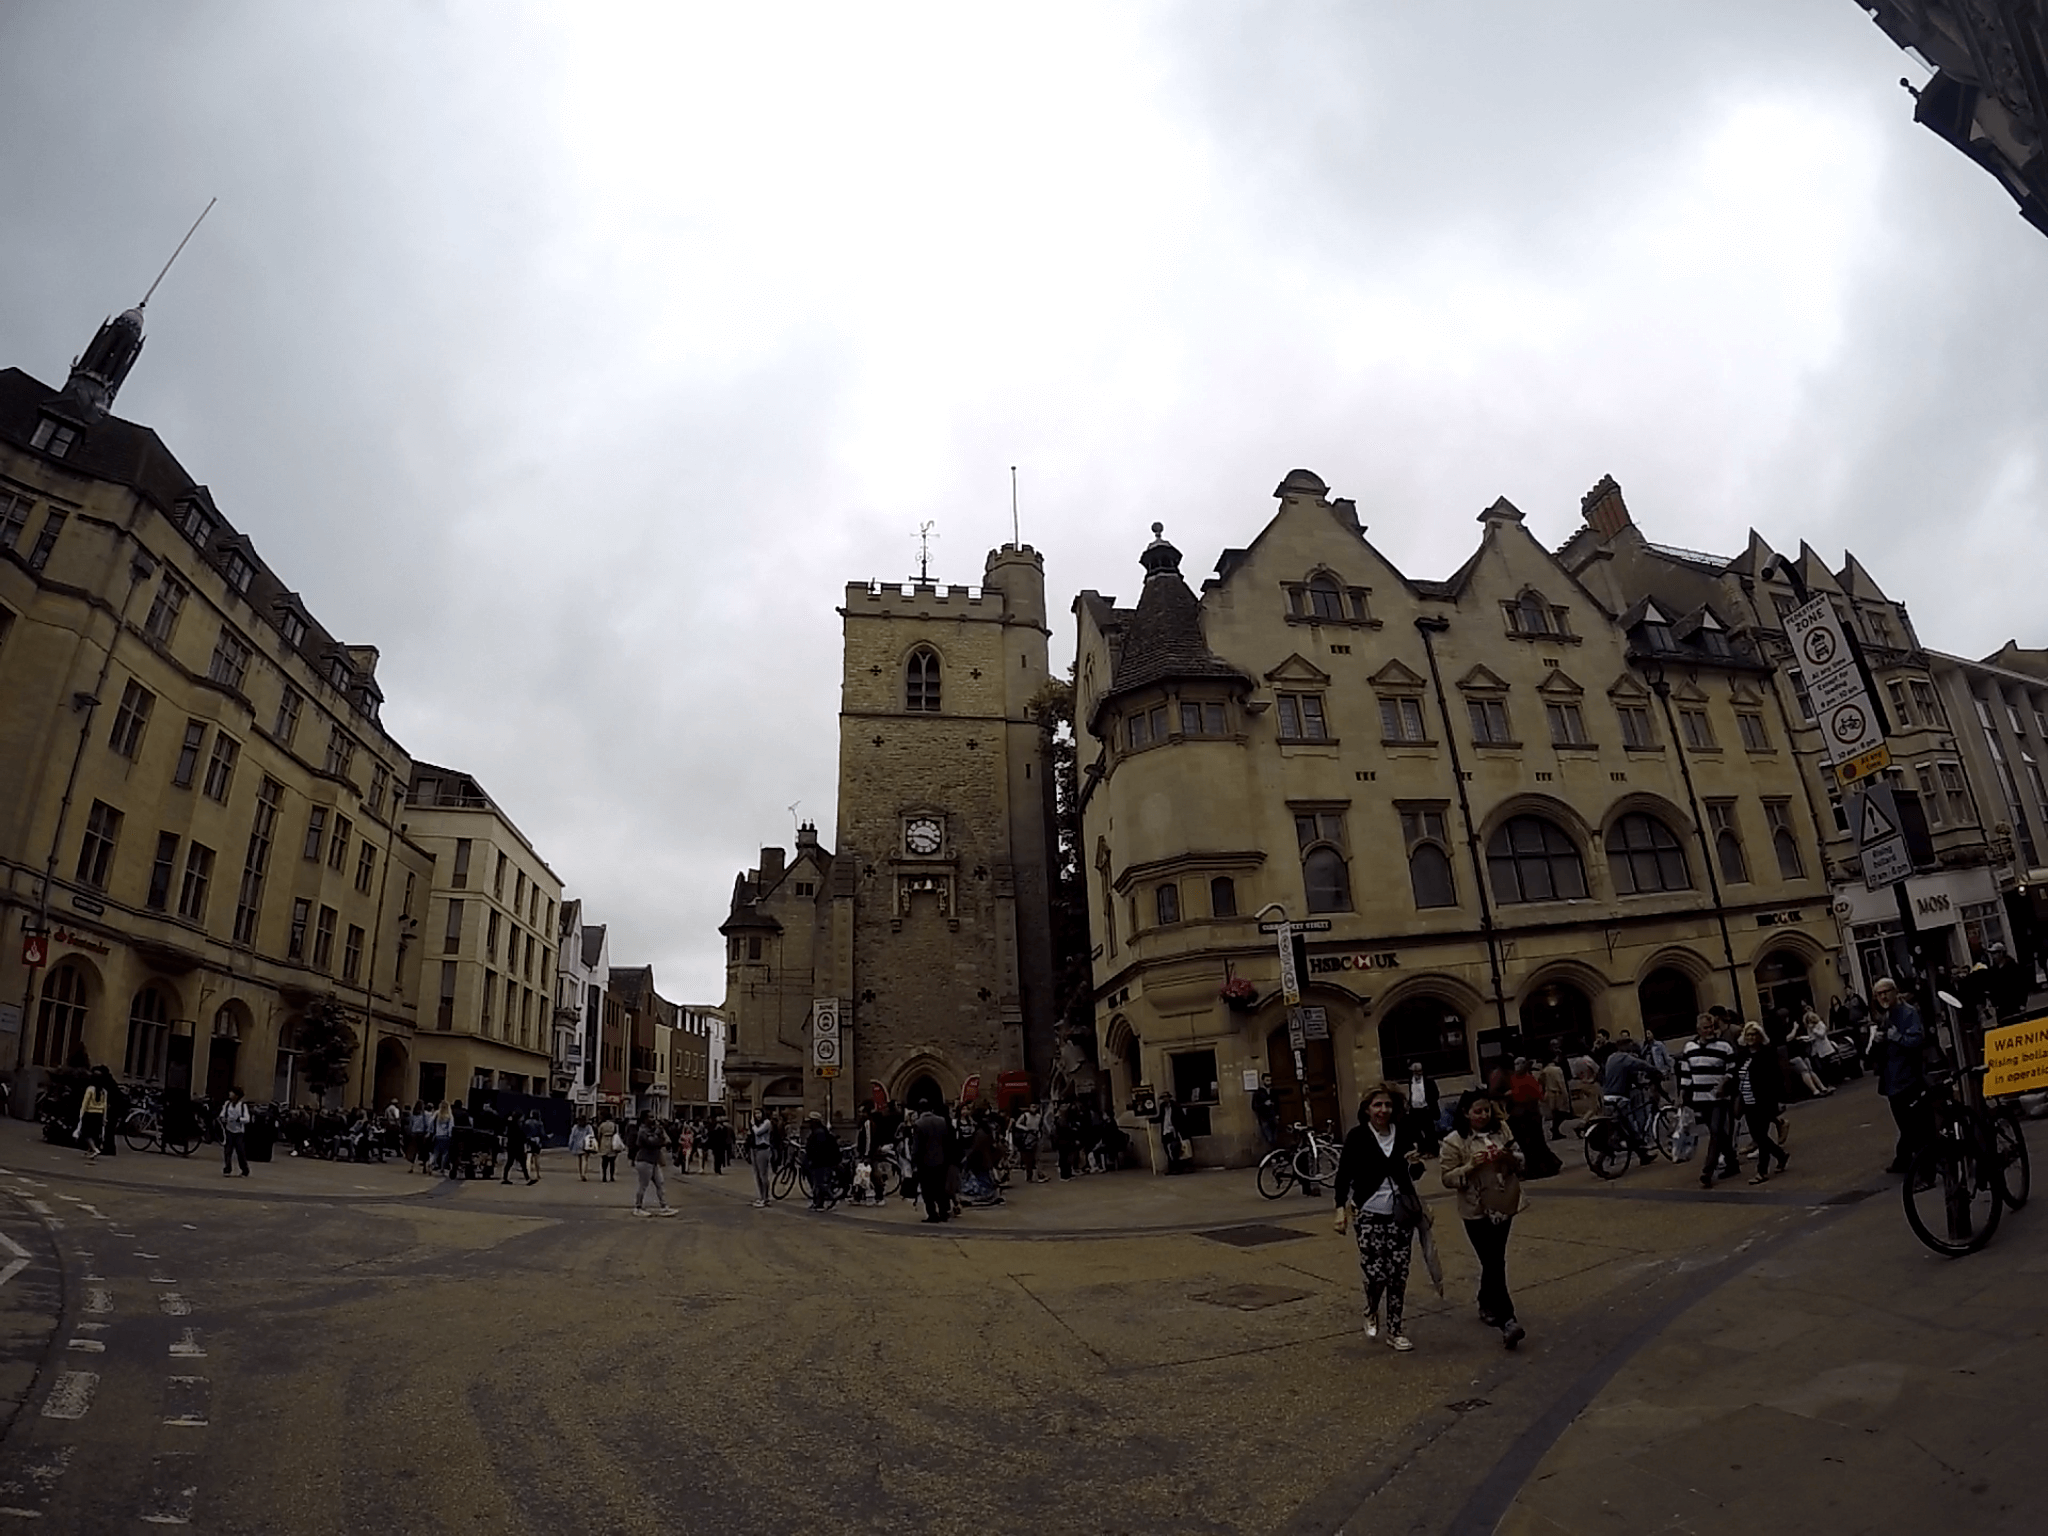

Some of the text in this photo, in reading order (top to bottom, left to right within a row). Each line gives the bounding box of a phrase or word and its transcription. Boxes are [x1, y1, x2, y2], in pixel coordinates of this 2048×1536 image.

[1795, 608, 1825, 633] ZONE
[1917, 894, 1950, 915] MOSS
[1310, 956, 1352, 974] HSBC
[1375, 953, 1399, 968] UK
[1988, 1056, 2018, 1069] Rising
[1995, 1075, 2005, 1085] in
